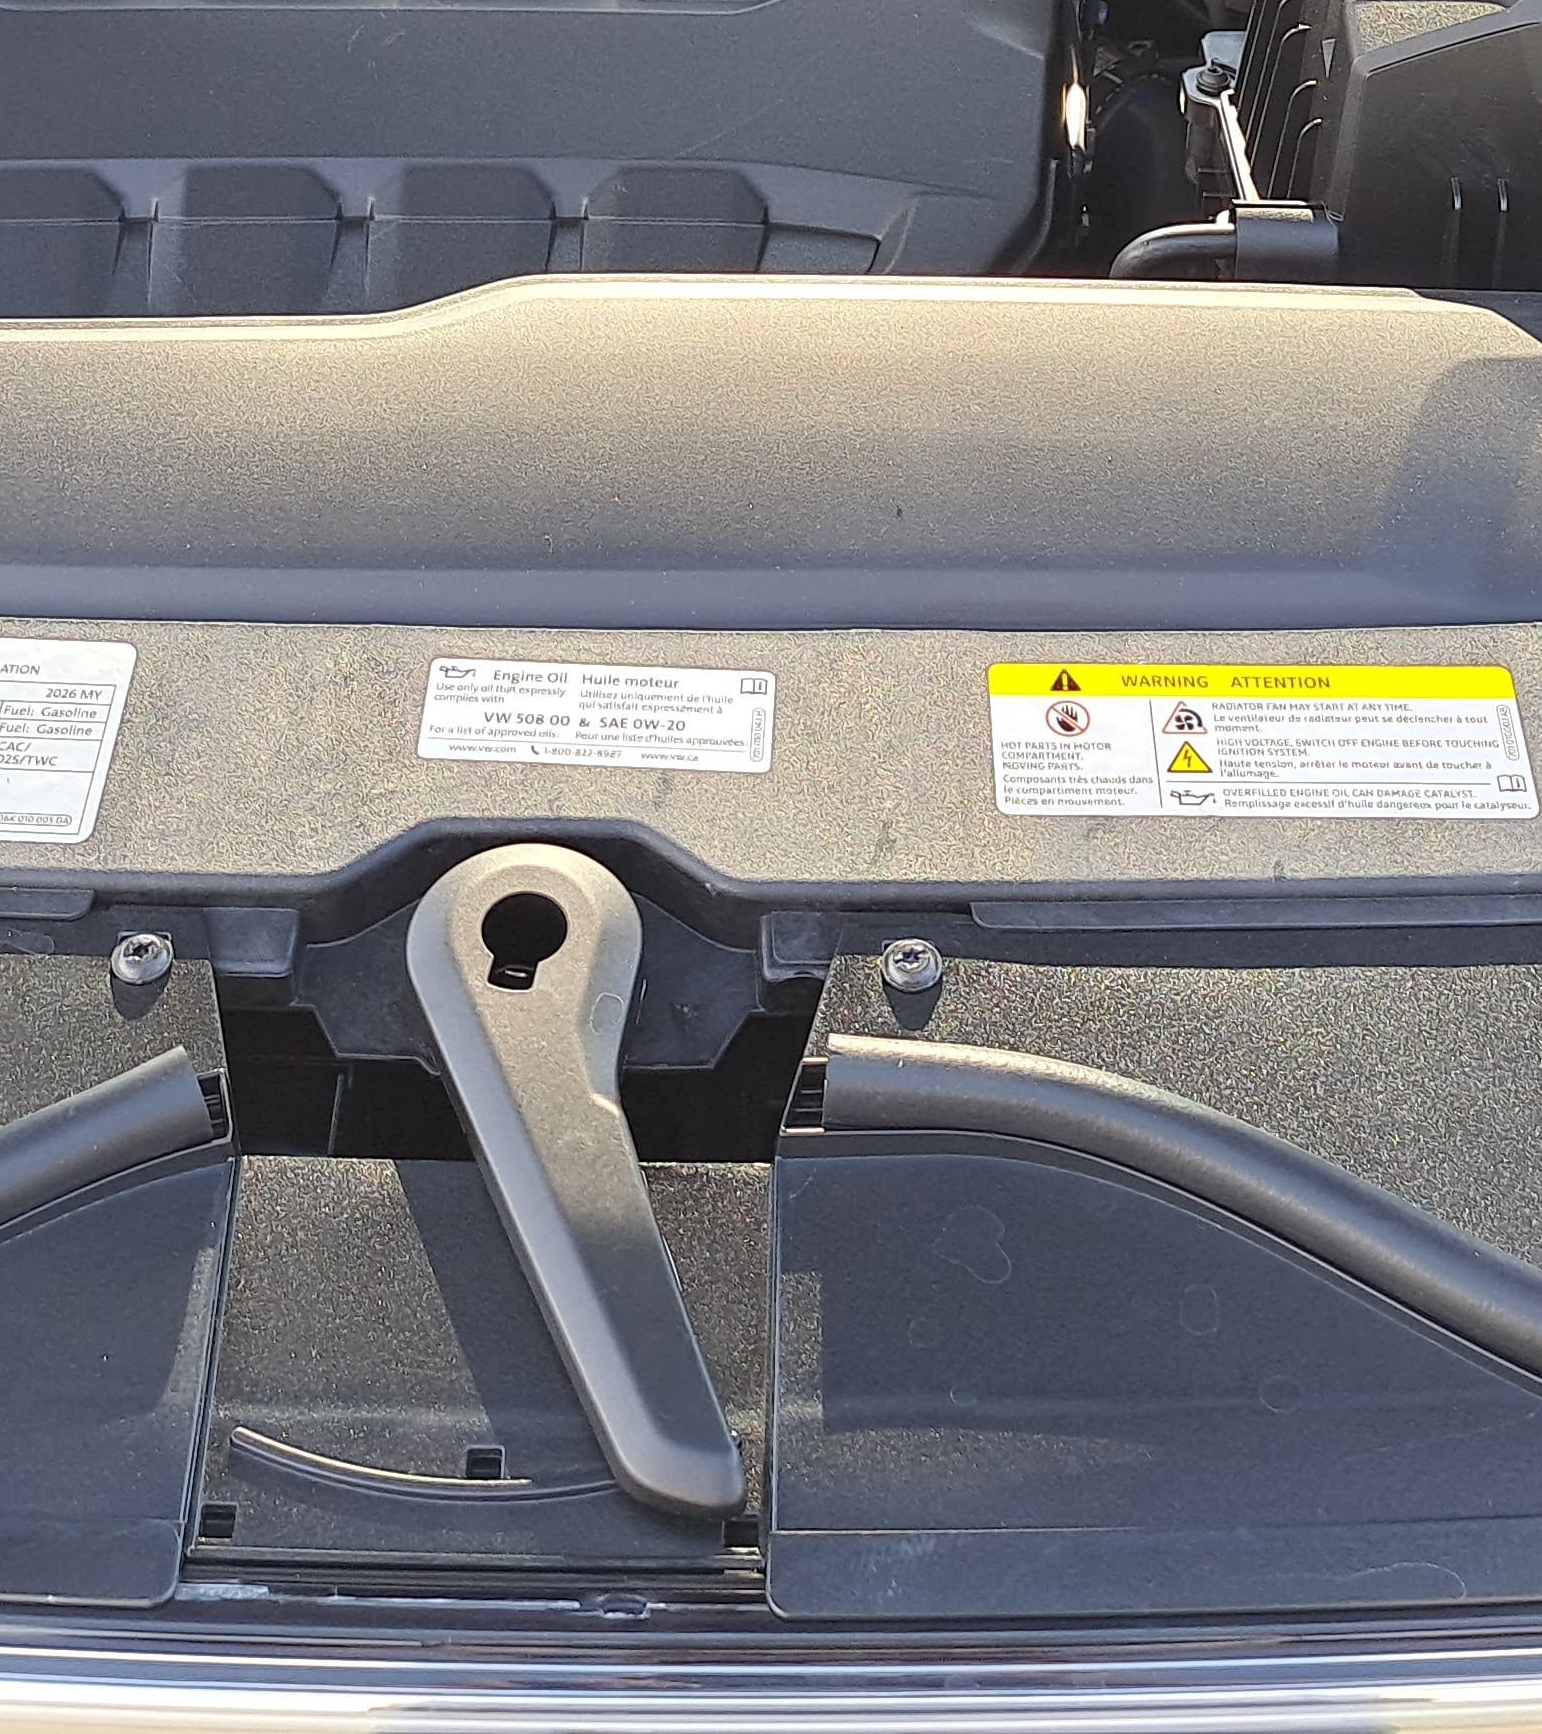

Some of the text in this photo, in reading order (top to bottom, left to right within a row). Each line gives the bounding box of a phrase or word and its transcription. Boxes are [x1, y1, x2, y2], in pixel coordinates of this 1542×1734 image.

[494, 670, 568, 684] Engine Oil
[582, 674, 679, 688] Huile moteur
[1121, 675, 1331, 689] WARNING ATTENTION
[45, 688, 103, 700] 2026 MY
[437, 683, 455, 691] Use
[457, 684, 478, 693] only
[519, 687, 566, 697] expressly
[434, 694, 479, 703] complies
[621, 693, 684, 703] uniquement
[687, 695, 699, 703] de
[4, 705, 97, 719] Fuel: Gasoline
[1313, 703, 1344, 711] START
[484, 712, 685, 731] VW 508 00 & SAE 0W-20
[0, 722, 93, 736] Fuel: Gasoline
[430, 725, 445, 733] For
[457, 726, 471, 734] list
[475, 726, 486, 735] of
[488, 728, 537, 738] approved
[1001, 742, 1021, 750] HOT
[1060, 742, 1070, 750] IN
[1074, 742, 1112, 750] MOTOR
[1217, 738, 1242, 746] HIGH
[1338, 739, 1358, 747] OFF
[1361, 739, 1400, 747] ENGINE
[1403, 739, 1442, 747] BEFORE
[1445, 740, 1499, 748] TOUCHING
[1218, 748, 1264, 756] IGNITION
[1003, 762, 1045, 770] MOVING
[1220, 760, 1251, 768] Haute
[1426, 761, 1439, 769] de
[1003, 774, 1066, 784] Composants
[1091, 776, 1127, 784] chauds
[1129, 776, 1153, 784] dans
[1004, 785, 1013, 793] le
[1017, 786, 1092, 796] compartiment
[1223, 789, 1286, 797] OVERFILLED
[1290, 789, 1329, 797] ENGINE
[1332, 789, 1349, 797] OIL
[1377, 789, 1421, 798] DAMAGE
[1225, 799, 1291, 809] Remplissage
